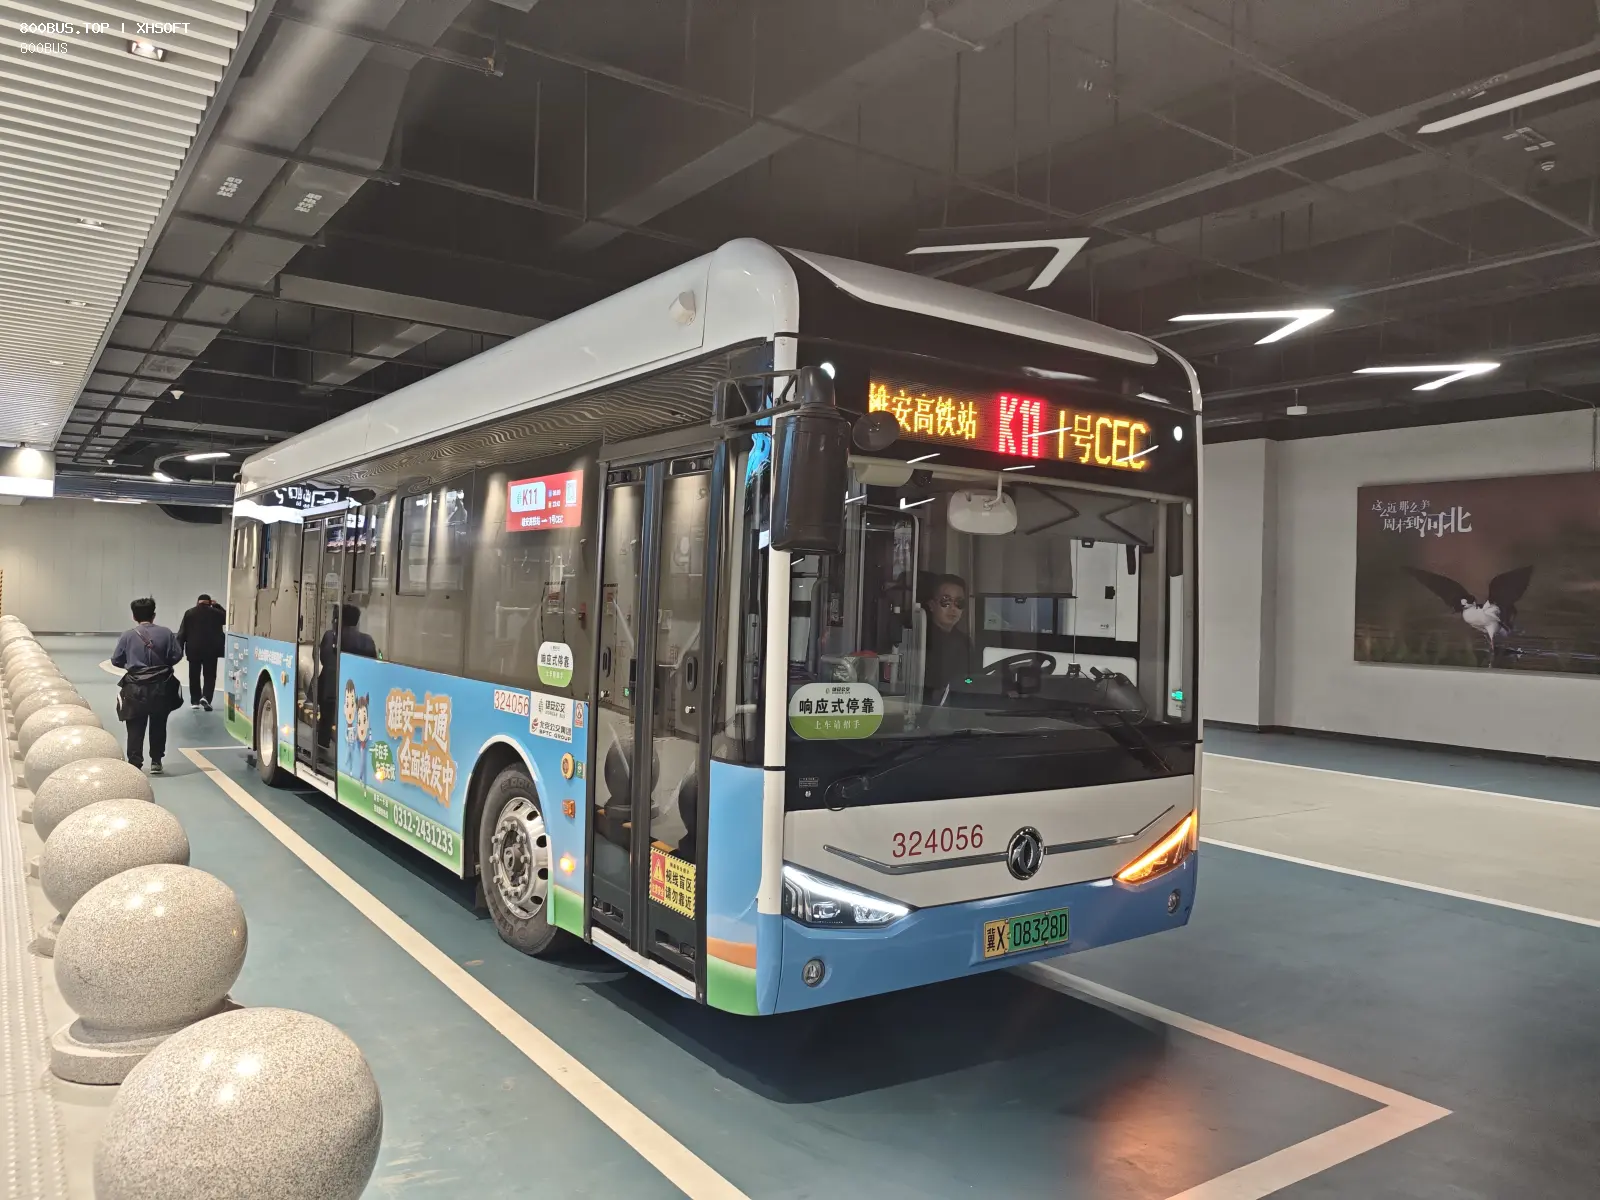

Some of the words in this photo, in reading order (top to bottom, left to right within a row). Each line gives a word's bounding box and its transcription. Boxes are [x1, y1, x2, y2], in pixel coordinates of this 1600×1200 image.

[869, 382, 978, 440] 雄安高铁站
[997, 394, 1042, 458] K11
[1057, 409, 1147, 470] 1号CEC
[522, 487, 538, 506] K11
[1382, 505, 1473, 538] 周末到河北
[494, 690, 529, 716] 324056
[799, 697, 875, 715] 响应式停靠
[388, 695, 448, 753] 雄安一卡通
[814, 719, 861, 730] 上车请招手
[399, 736, 454, 802] 全面换发中
[393, 803, 454, 856] 0312-2431233
[892, 824, 984, 858] 324056
[665, 868, 692, 893] 视线盲区
[665, 886, 692, 911] 请勿靠近
[986, 924, 1005, 953] 冀X
[1013, 913, 1068, 947] 08328D
